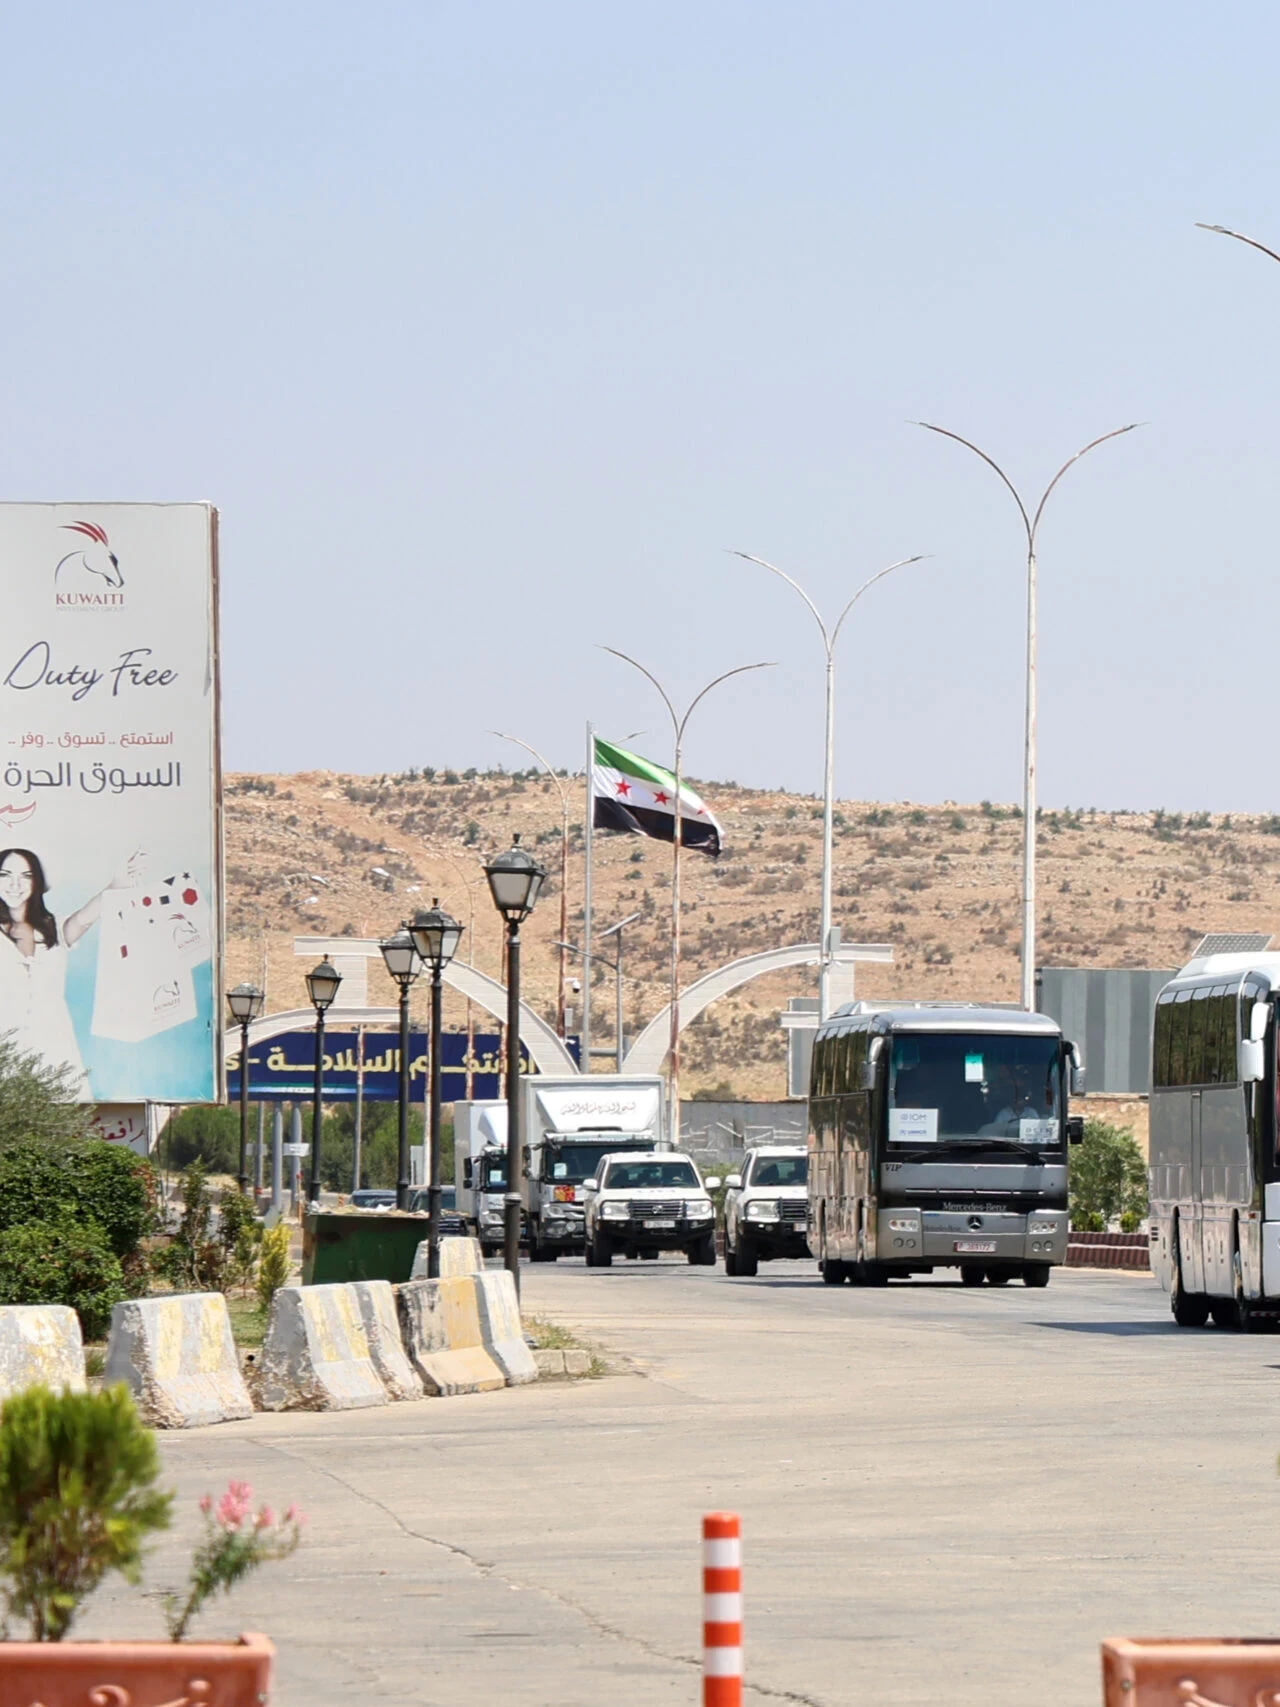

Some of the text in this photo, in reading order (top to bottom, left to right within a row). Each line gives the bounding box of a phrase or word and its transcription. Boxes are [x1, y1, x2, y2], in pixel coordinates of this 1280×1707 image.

[55, 593, 124, 605] KUWAITI
[3, 641, 178, 701] Duty Free
[20, 731, 44, 748] وفر
[57, 731, 105, 748] تسوق
[119, 731, 173, 748] استمتع
[4, 761, 181, 794] السوق الحرة
[885, 1164, 903, 1172] VIP
[942, 1202, 1008, 1212] Mercedes-Benz
